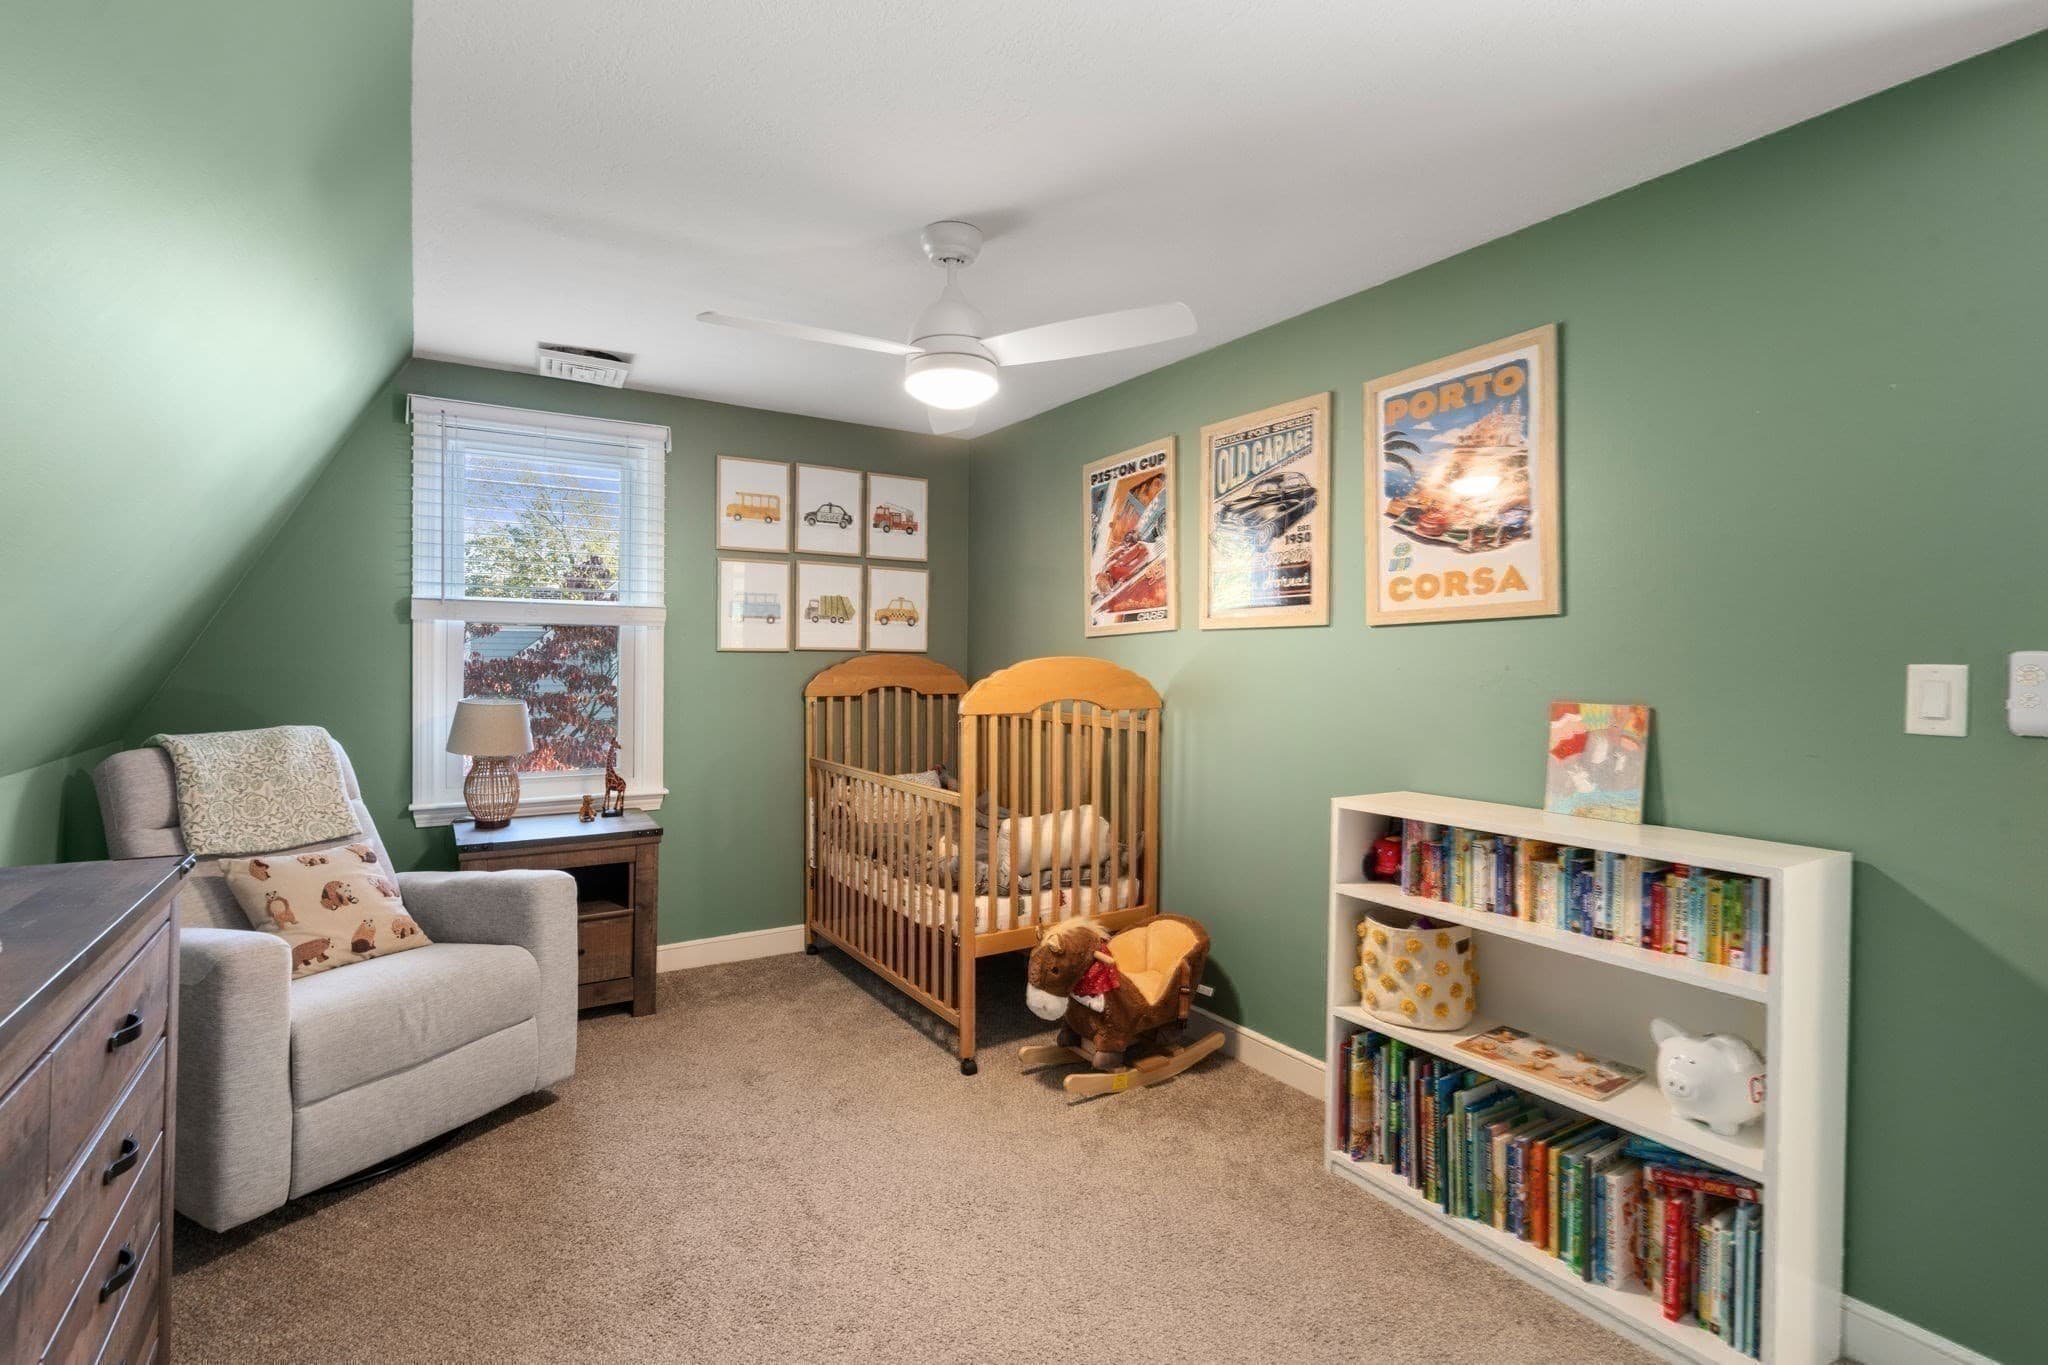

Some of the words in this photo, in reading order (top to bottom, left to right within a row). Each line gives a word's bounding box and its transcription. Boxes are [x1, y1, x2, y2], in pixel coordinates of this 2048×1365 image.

[1386, 365, 1525, 426] PORTO
[1091, 461, 1136, 486] PISTON
[1140, 452, 1166, 470] CUP
[1216, 444, 1250, 495] OLD
[1251, 427, 1312, 475] GARAGE
[1285, 532, 1311, 545] 1950
[1388, 565, 1529, 602] CORSA
[1137, 611, 1165, 621] CARS
